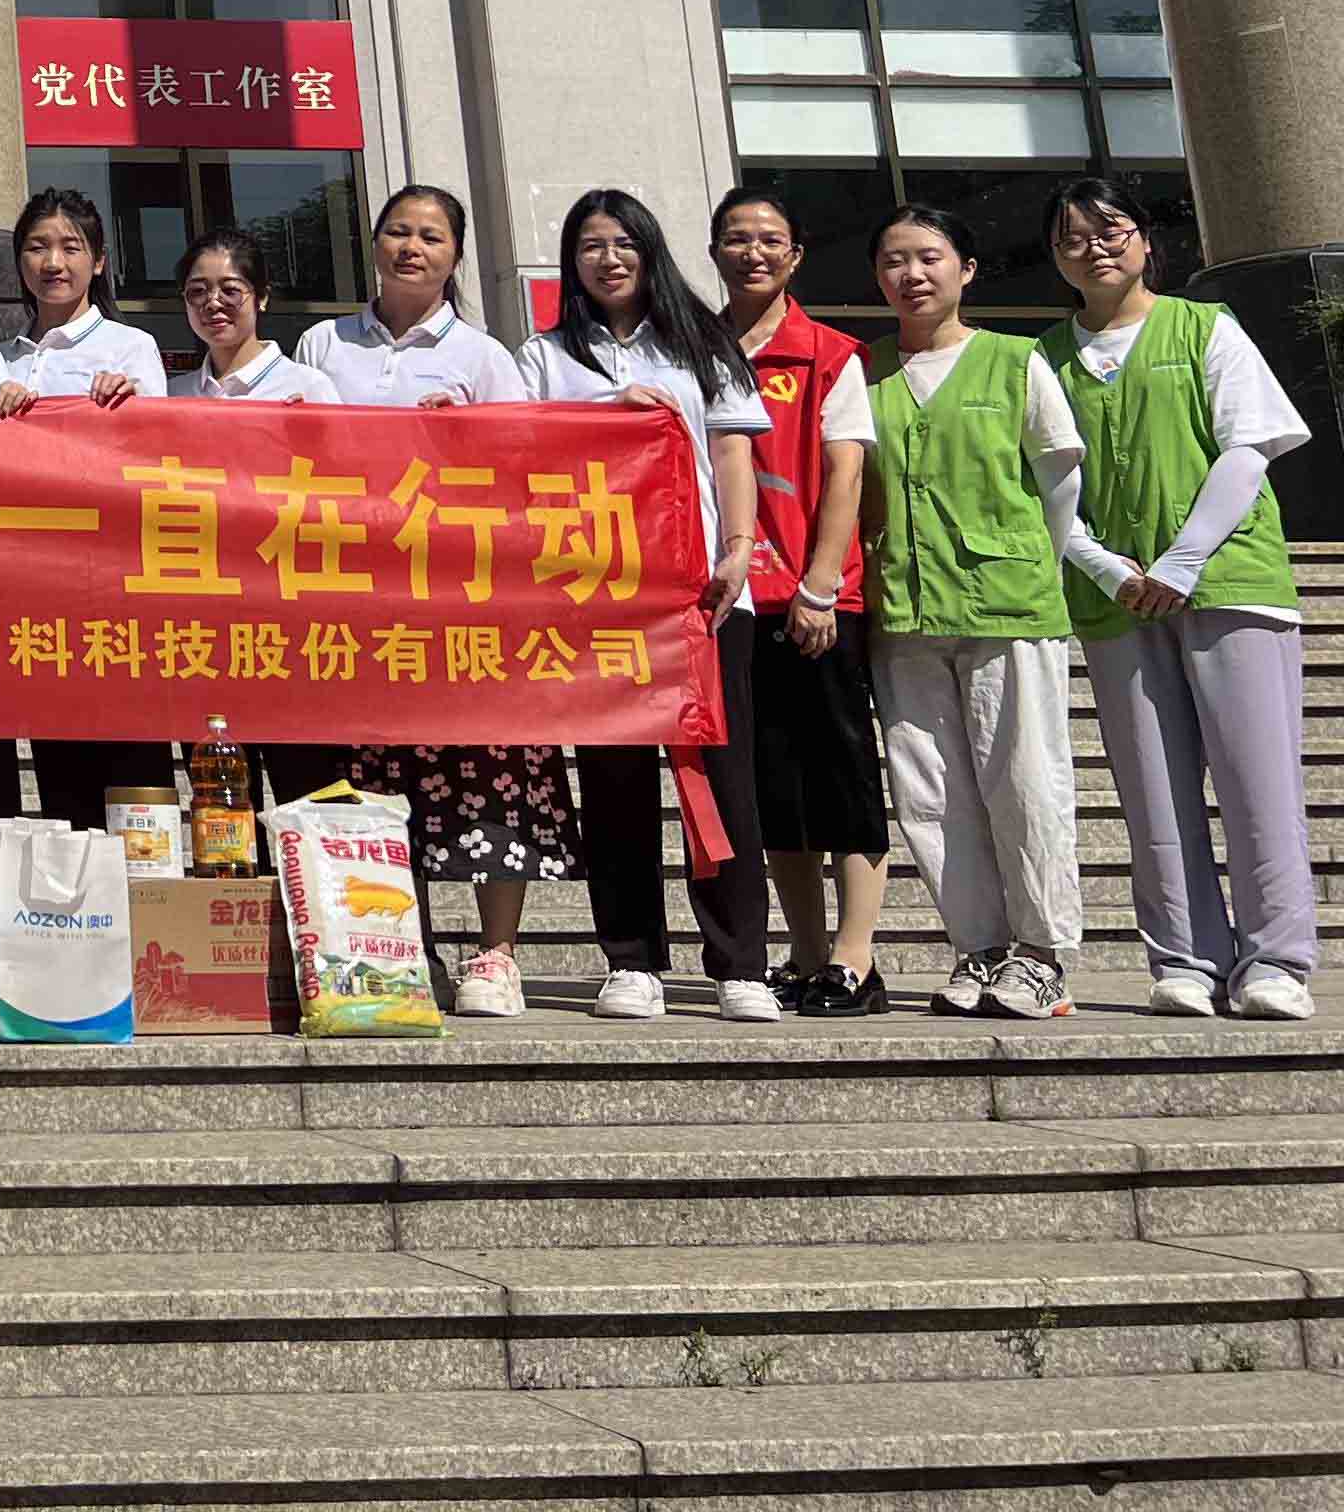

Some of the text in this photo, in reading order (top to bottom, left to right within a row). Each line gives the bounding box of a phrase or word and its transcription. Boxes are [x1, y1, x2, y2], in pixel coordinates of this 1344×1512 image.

[31, 61, 337, 111] 党代表工作室
[320, 835, 411, 870] 金龙鱼
[14, 910, 112, 928] AOZON 澳中
